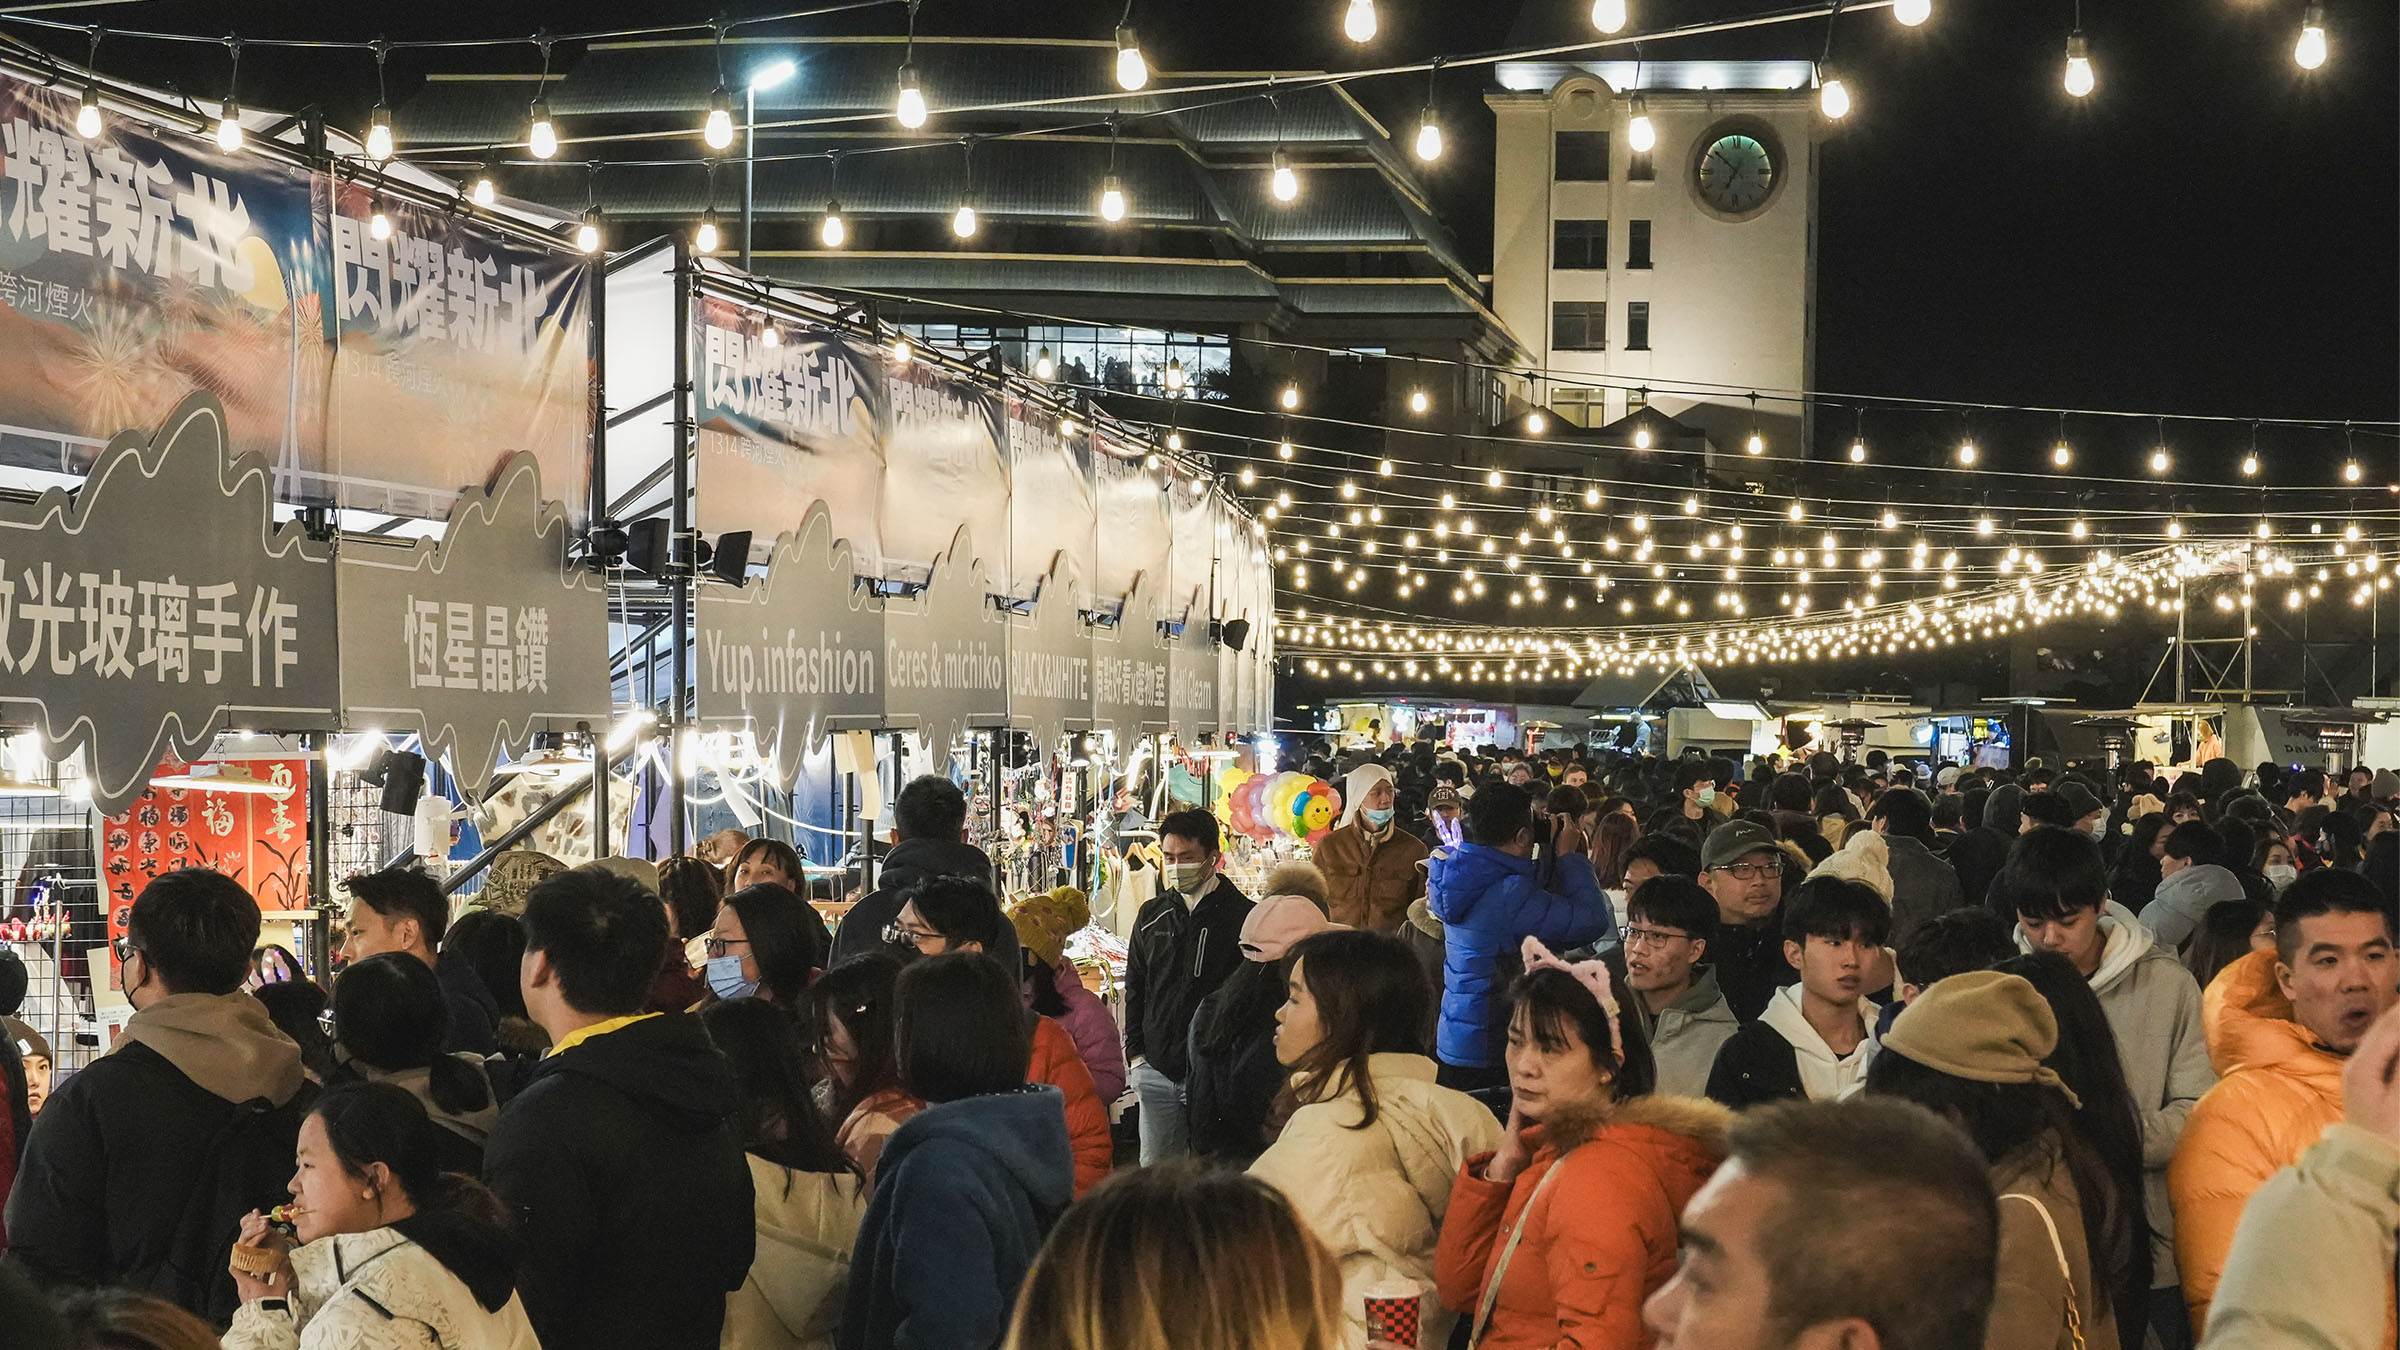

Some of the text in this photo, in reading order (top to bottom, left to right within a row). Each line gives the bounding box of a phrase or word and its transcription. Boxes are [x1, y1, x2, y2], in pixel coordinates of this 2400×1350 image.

[0, 117, 255, 297] 耀新北
[331, 213, 550, 356] 閃耀新北
[0, 558, 298, 688] 光玻璃手作
[403, 593, 549, 695] 恆星晶鑽
[705, 626, 874, 710] Yup.infashion
[888, 638, 1002, 690] Ceres & michiko
[1011, 649, 1088, 701] BLACK&WHITE
